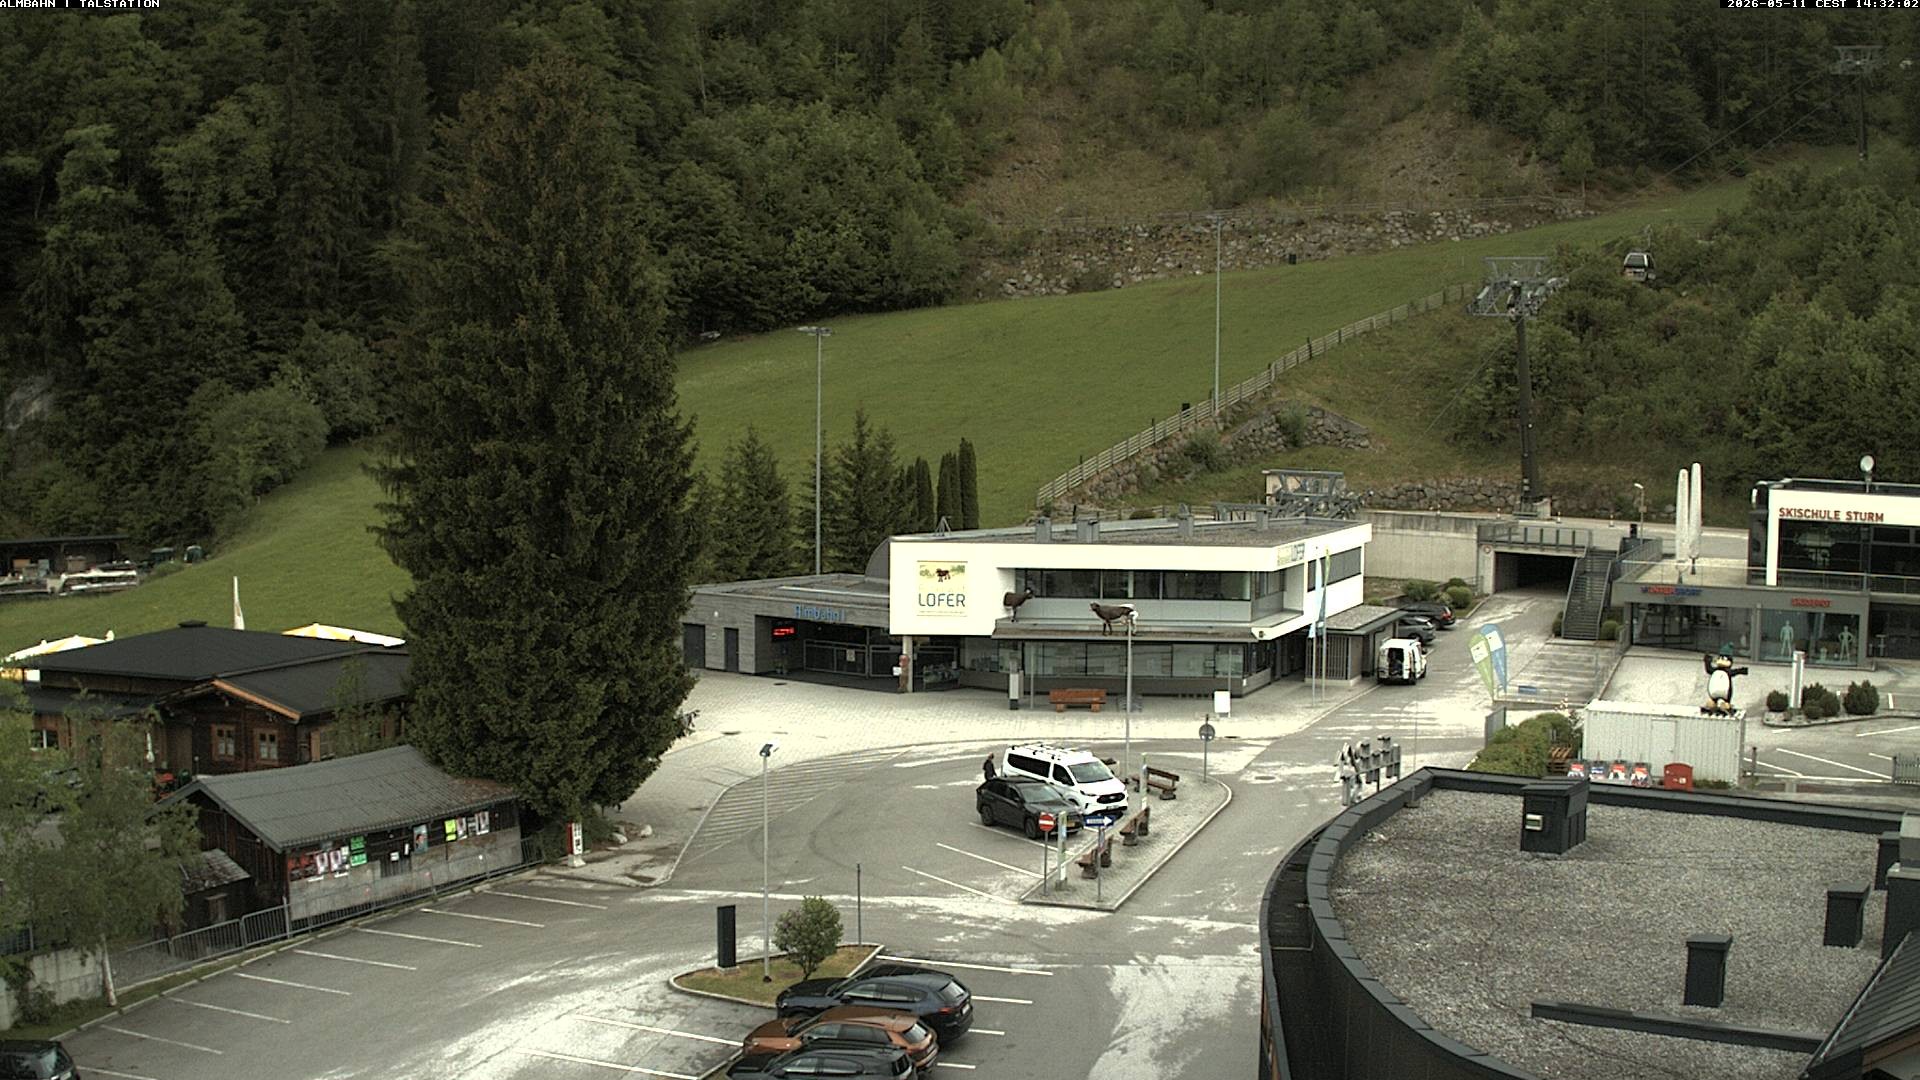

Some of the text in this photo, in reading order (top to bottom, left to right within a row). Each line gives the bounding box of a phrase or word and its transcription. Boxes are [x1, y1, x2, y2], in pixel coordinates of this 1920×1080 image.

[1778, 507, 1885, 522] SKISCHULE STURM
[918, 593, 966, 608] LOFER
